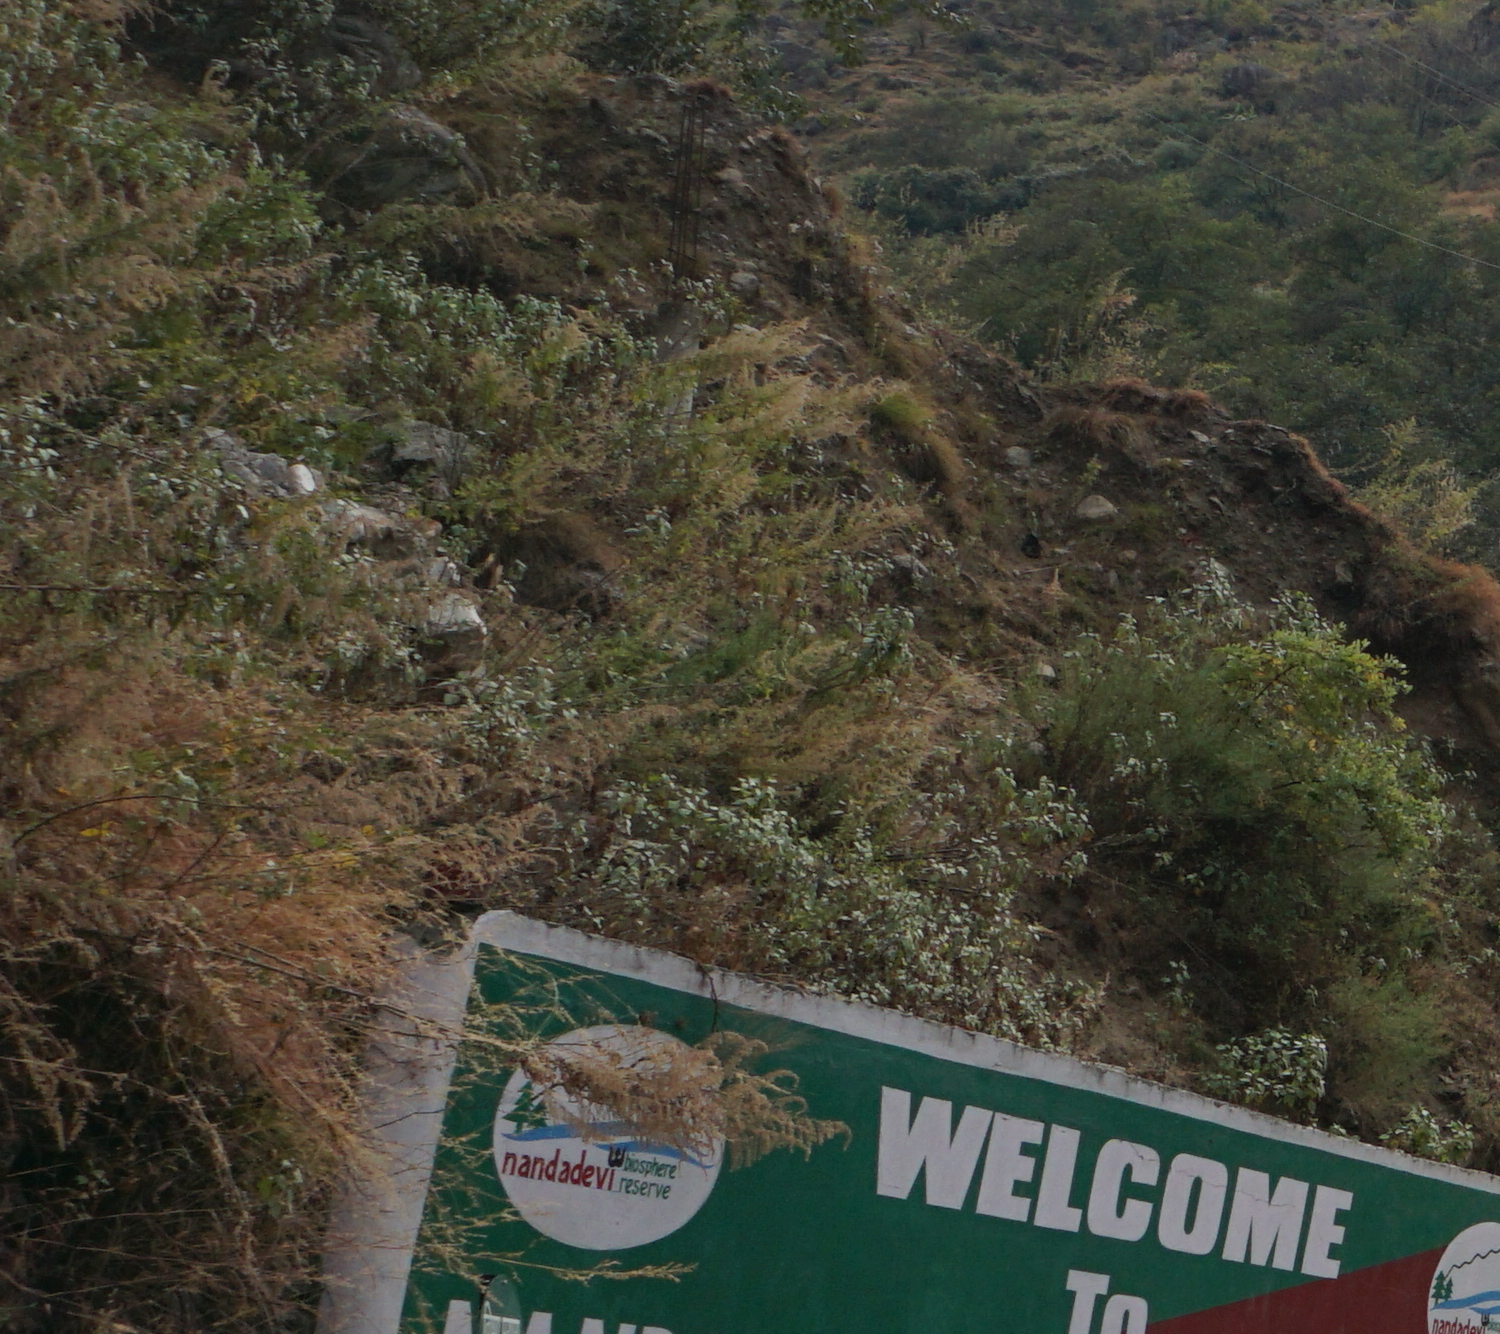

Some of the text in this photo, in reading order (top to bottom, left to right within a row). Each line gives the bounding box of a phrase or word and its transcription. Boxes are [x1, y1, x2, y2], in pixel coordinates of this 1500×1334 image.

[501, 1149, 616, 1191] nandadevi
[623, 1153, 678, 1180] biosphere
[876, 1086, 1353, 1279] WELCOME
[618, 1176, 672, 1200] reserve
